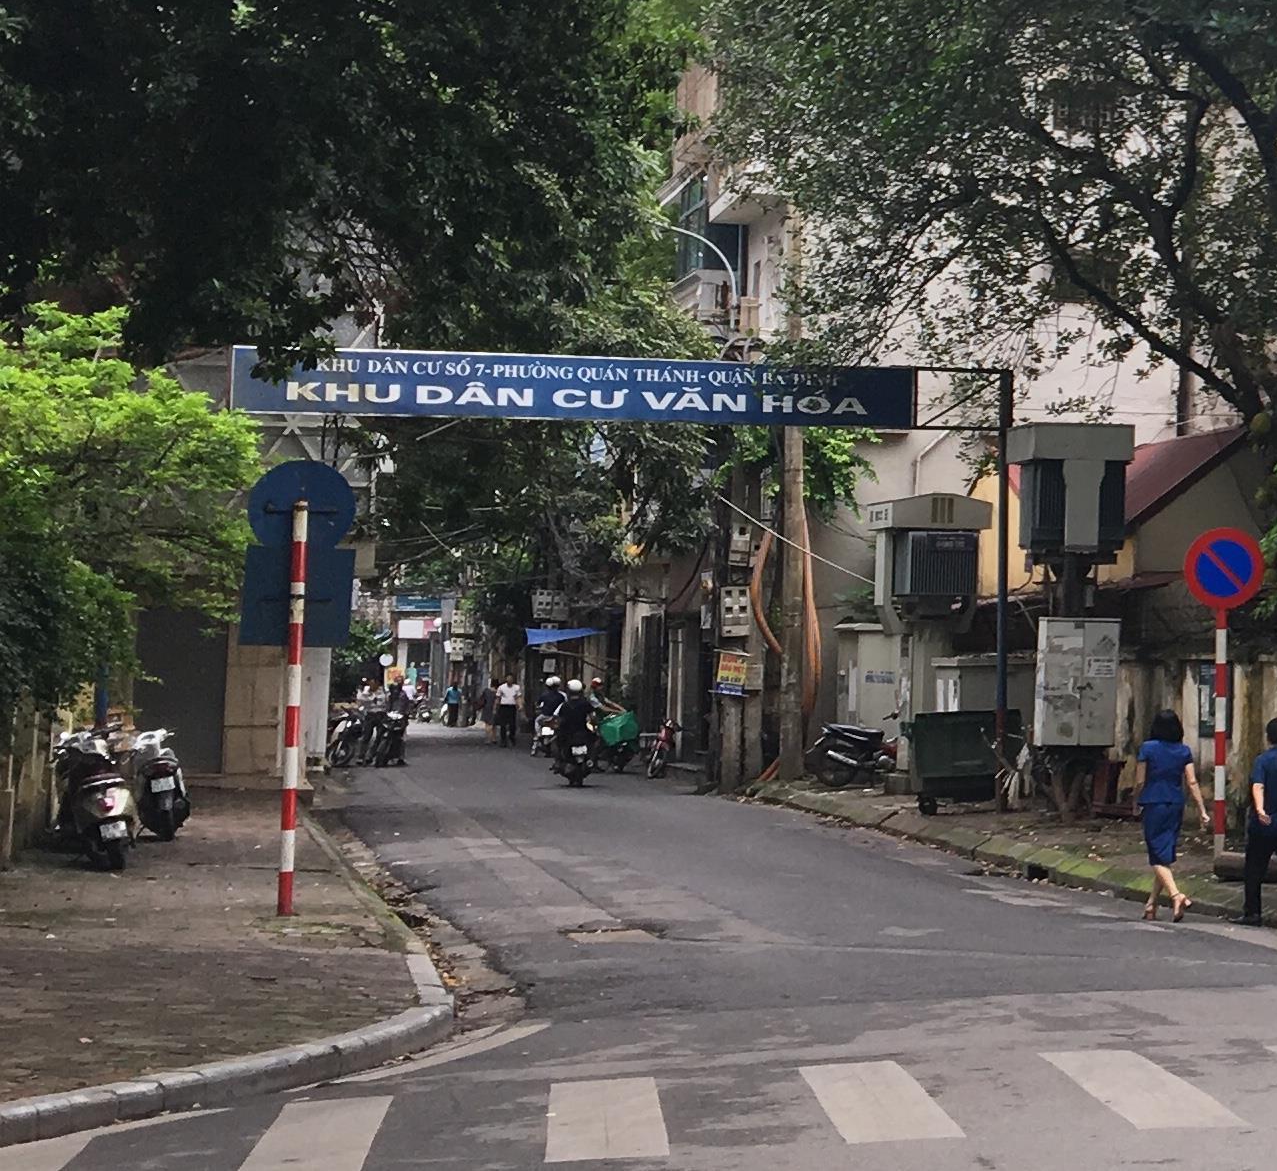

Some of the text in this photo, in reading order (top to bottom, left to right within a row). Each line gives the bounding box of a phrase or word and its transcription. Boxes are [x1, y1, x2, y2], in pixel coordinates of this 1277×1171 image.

[316, 357, 360, 373] KHU
[367, 357, 409, 374] DÂN
[413, 360, 442, 375] CƯ
[444, 358, 472, 377] SỐ
[577, 366, 629, 383] QUÁN
[286, 381, 868, 415] KHU DÂN CƯ VĂN HÓA
